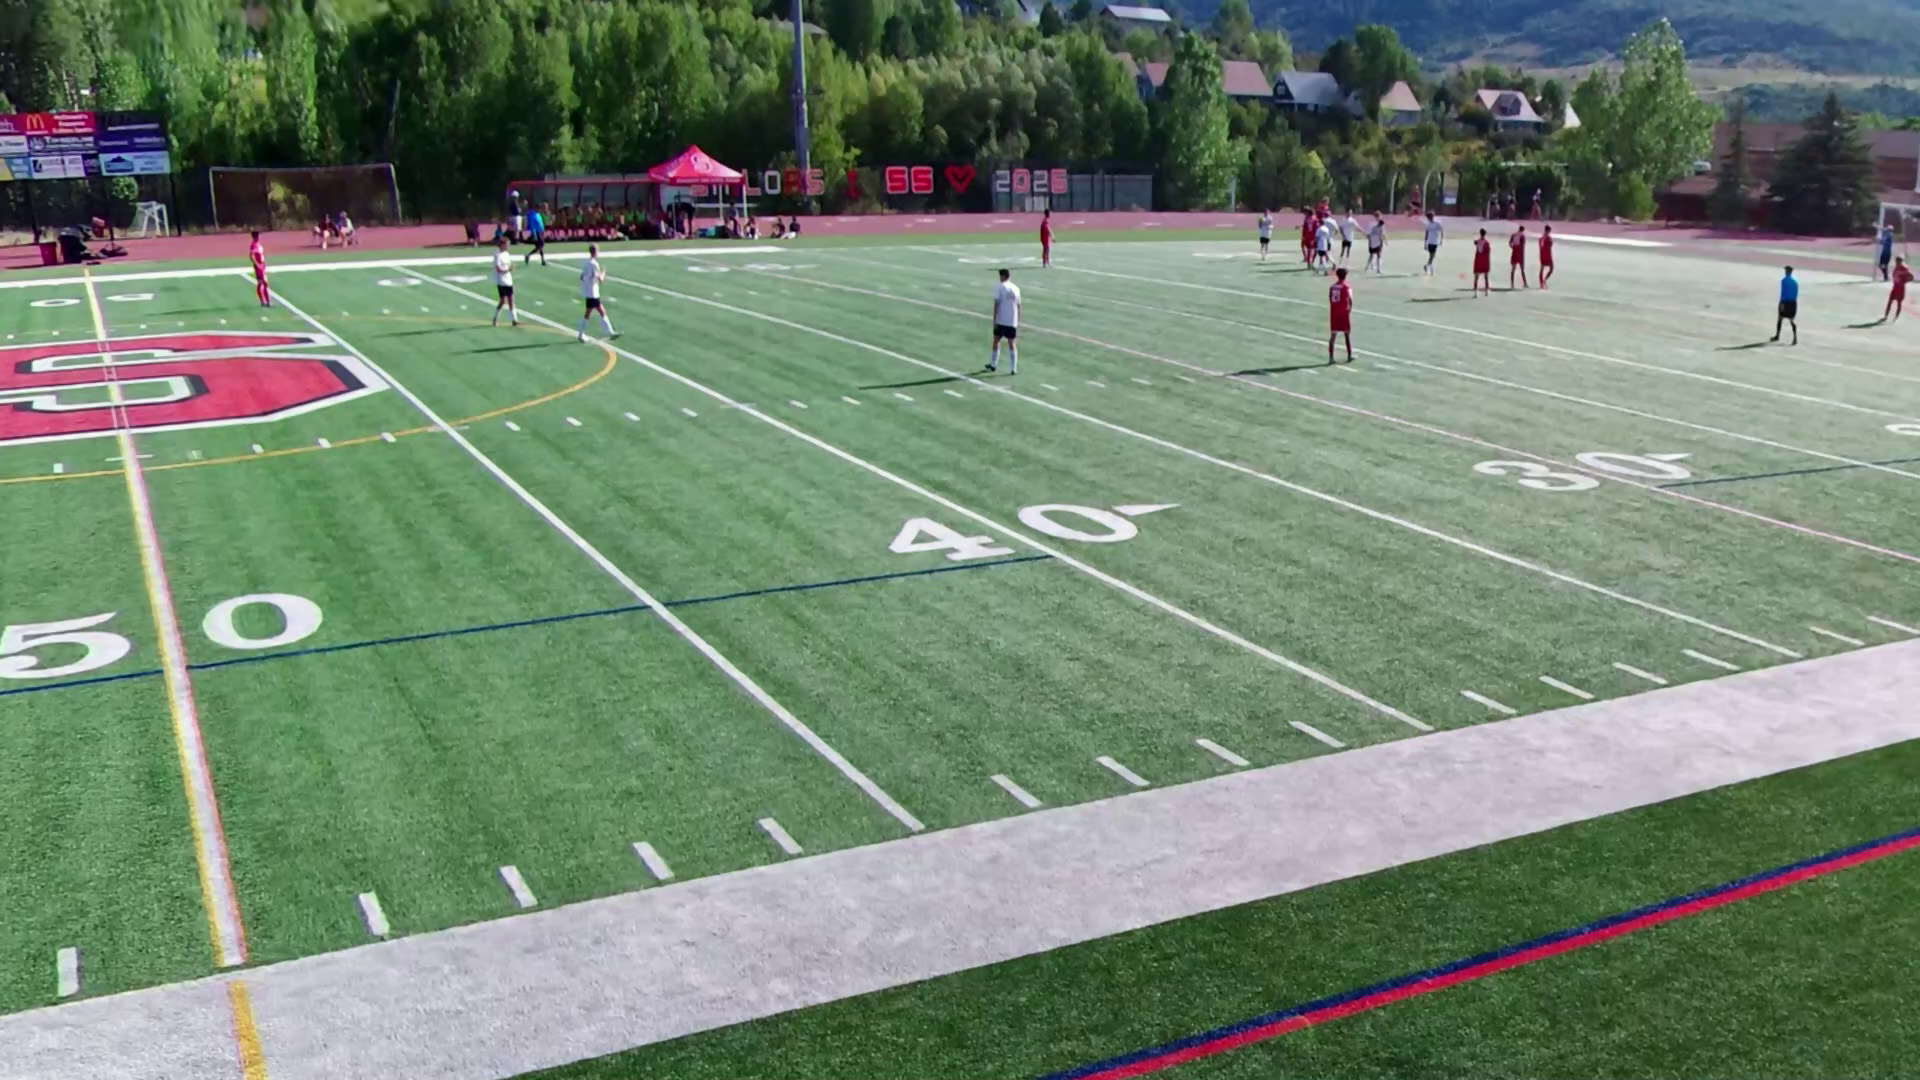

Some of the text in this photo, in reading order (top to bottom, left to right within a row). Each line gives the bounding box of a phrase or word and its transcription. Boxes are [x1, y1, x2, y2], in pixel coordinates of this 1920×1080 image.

[886, 166, 933, 194] SS
[996, 168, 1067, 194] 2026
[1473, 452, 1691, 491] 30
[888, 504, 1138, 560] 40
[0, 593, 323, 679] 50
